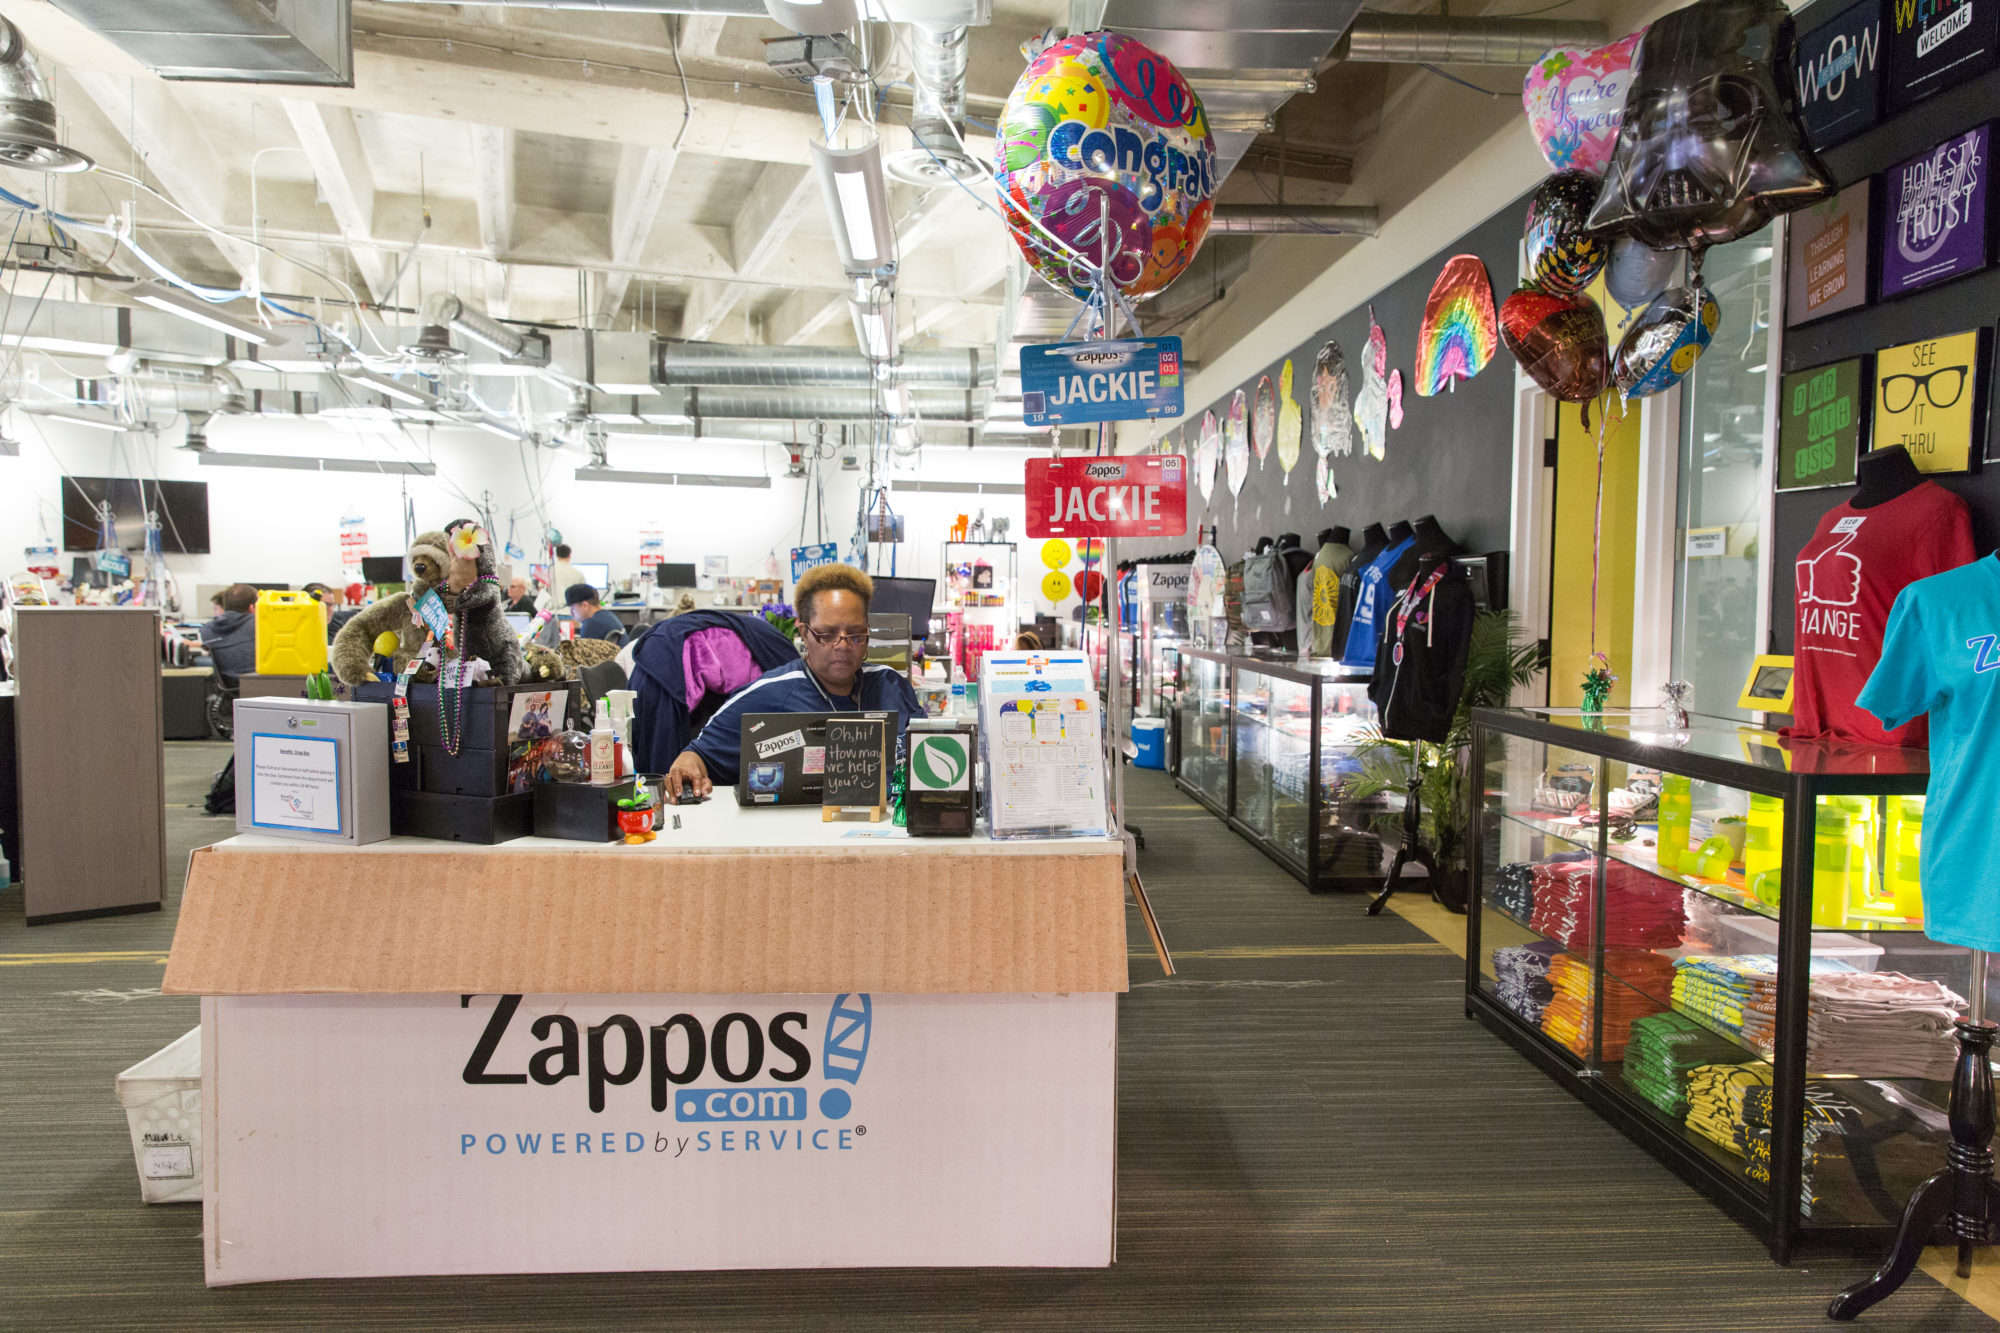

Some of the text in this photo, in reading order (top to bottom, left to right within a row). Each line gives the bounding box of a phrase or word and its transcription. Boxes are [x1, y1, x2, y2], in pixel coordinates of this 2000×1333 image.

[1920, 7, 1968, 52] WELCOME
[1798, 20, 1880, 108] WOW
[1548, 79, 1617, 128] You're
[1902, 135, 1981, 190] HONESTY
[1901, 181, 1976, 247] TRUST
[1810, 223, 1844, 257] THROUGH
[1809, 248, 1845, 283] LEARNING
[1808, 271, 1846, 307] WE GROW
[1162, 342, 1172, 351] 01
[1162, 353, 1174, 362] 02
[1911, 342, 1937, 368] SEE
[1162, 364, 1174, 373] 03
[1163, 376, 1175, 385] 04
[1049, 370, 1157, 405] JACKIE
[1032, 414, 1045, 422] 19
[1164, 405, 1177, 414] 99
[1913, 403, 1926, 425] IT
[1901, 431, 1936, 455] THRU
[1085, 463, 1121, 478] Zappos
[1049, 485, 1161, 522] JACKIE
[1152, 571, 1190, 589] Zappo
[1800, 607, 1862, 641] HANGE
[1966, 634, 2000, 673] Z
[755, 734, 795, 754] Zappos
[829, 743, 857, 761] How
[858, 749, 882, 765] may
[826, 760, 876, 777] we help
[828, 775, 859, 794] you?
[460, 993, 811, 1113] Zappos
[682, 1088, 796, 1119] .com
[460, 1128, 853, 1158] POWERED by SERVICE
